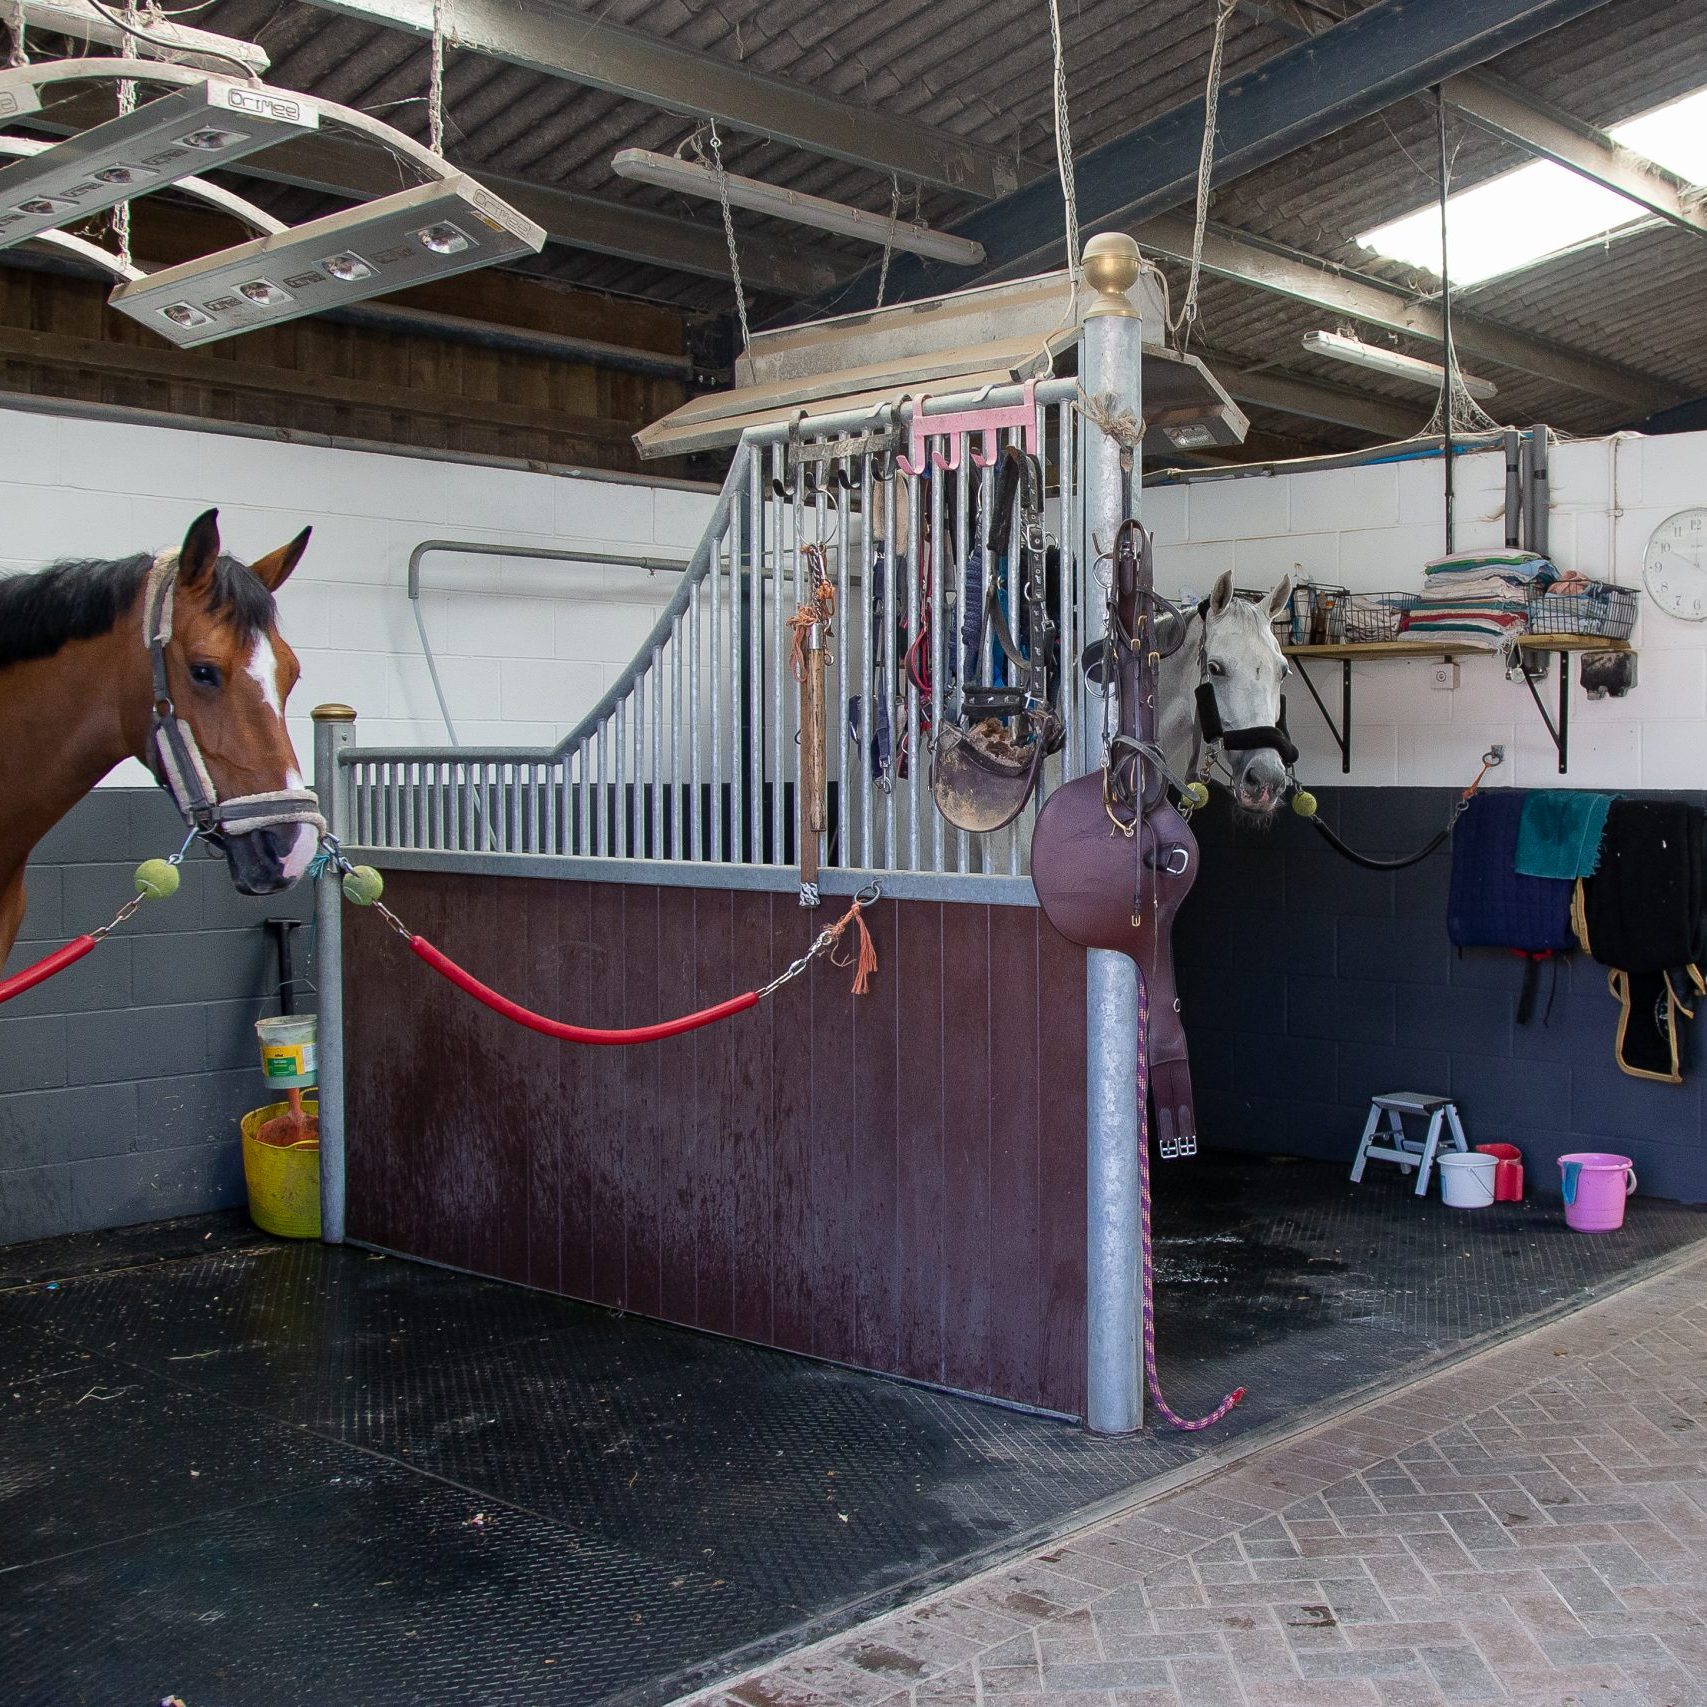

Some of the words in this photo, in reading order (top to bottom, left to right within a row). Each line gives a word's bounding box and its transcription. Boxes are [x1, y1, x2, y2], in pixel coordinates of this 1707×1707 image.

[1690, 519, 1702, 531] 12
[1673, 526, 1682, 537] 11
[1660, 543, 1671, 554] 10
[1654, 561, 1663, 573] 9
[1660, 582, 1669, 592] 8
[1675, 595, 1682, 606] 7
[1693, 599, 1702, 610] 6
